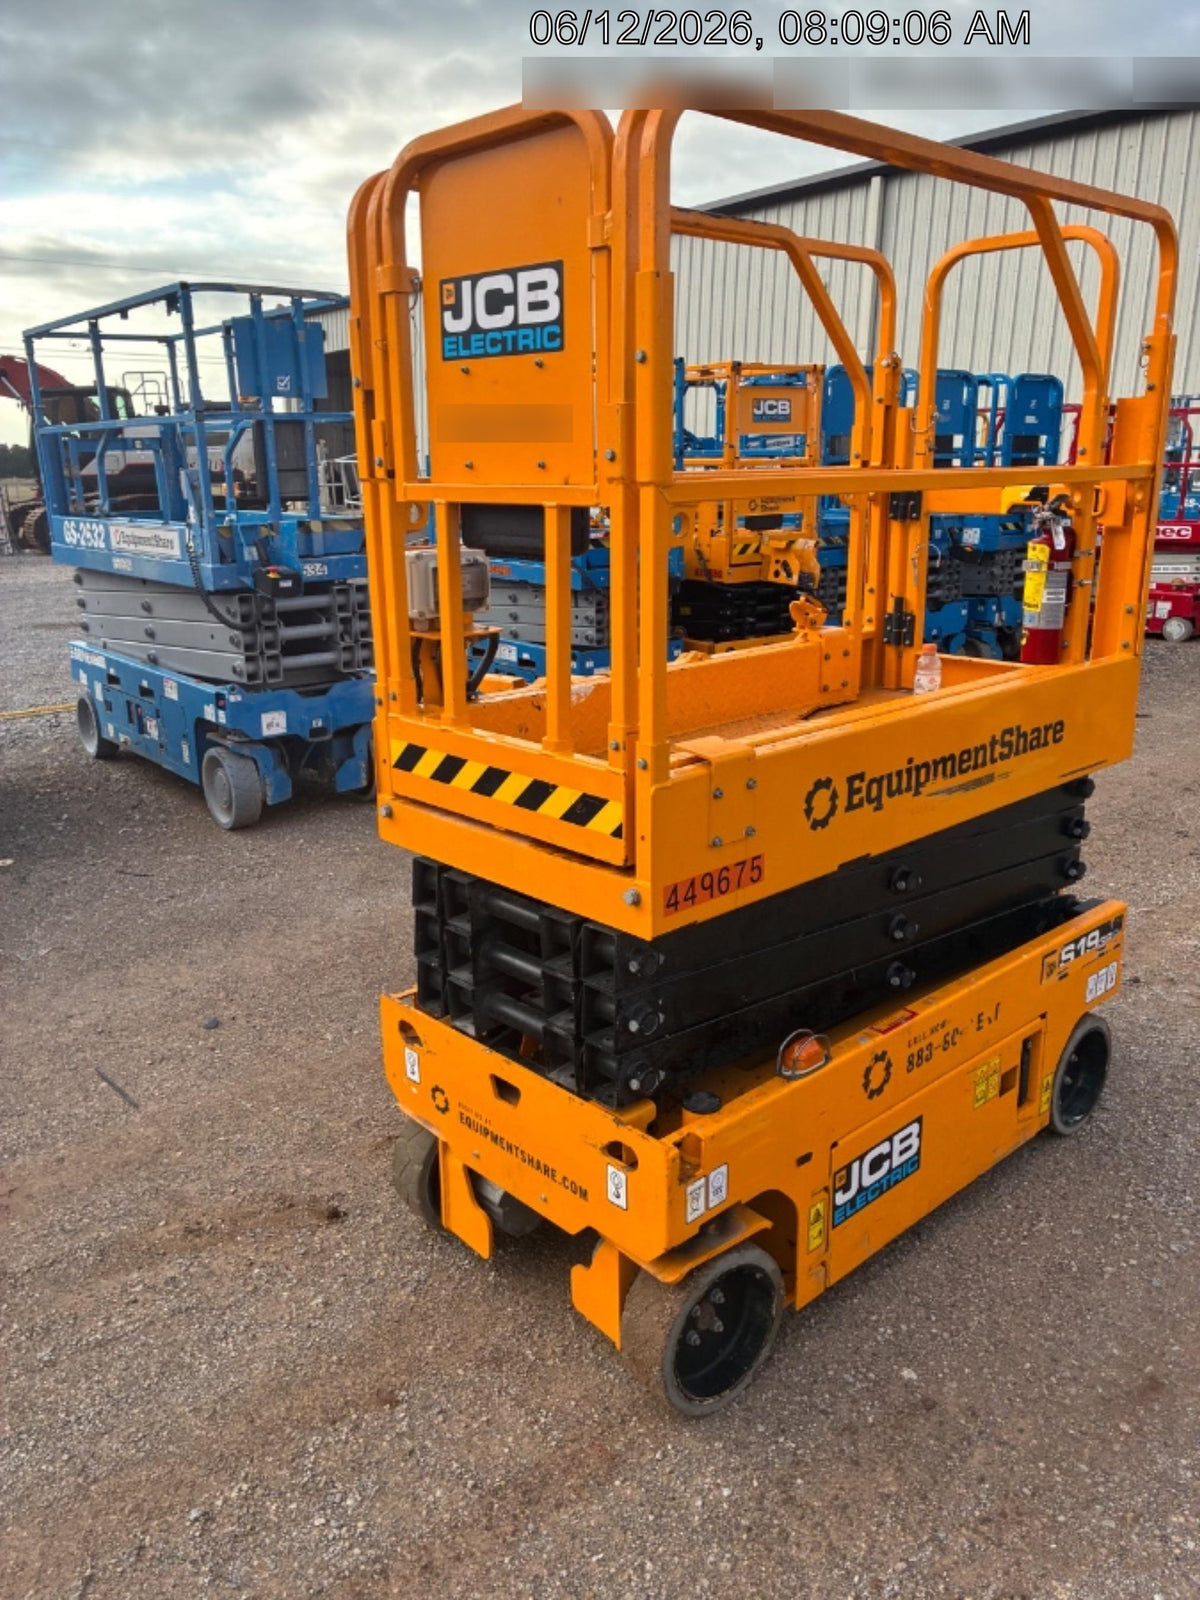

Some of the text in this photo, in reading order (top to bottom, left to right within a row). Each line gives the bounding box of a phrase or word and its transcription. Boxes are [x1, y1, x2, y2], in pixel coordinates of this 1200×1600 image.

[443, 267, 560, 333] JCB
[443, 325, 561, 358] ELECTRIC
[753, 399, 790, 415] JCB
[844, 719, 1065, 813] EquipmentShare
[666, 854, 762, 911] 449675
[459, 1111, 589, 1202] EQUIPMENTSHARE.COM
[833, 1154, 919, 1226] ELECTRIC
[835, 1122, 920, 1207] JCB
